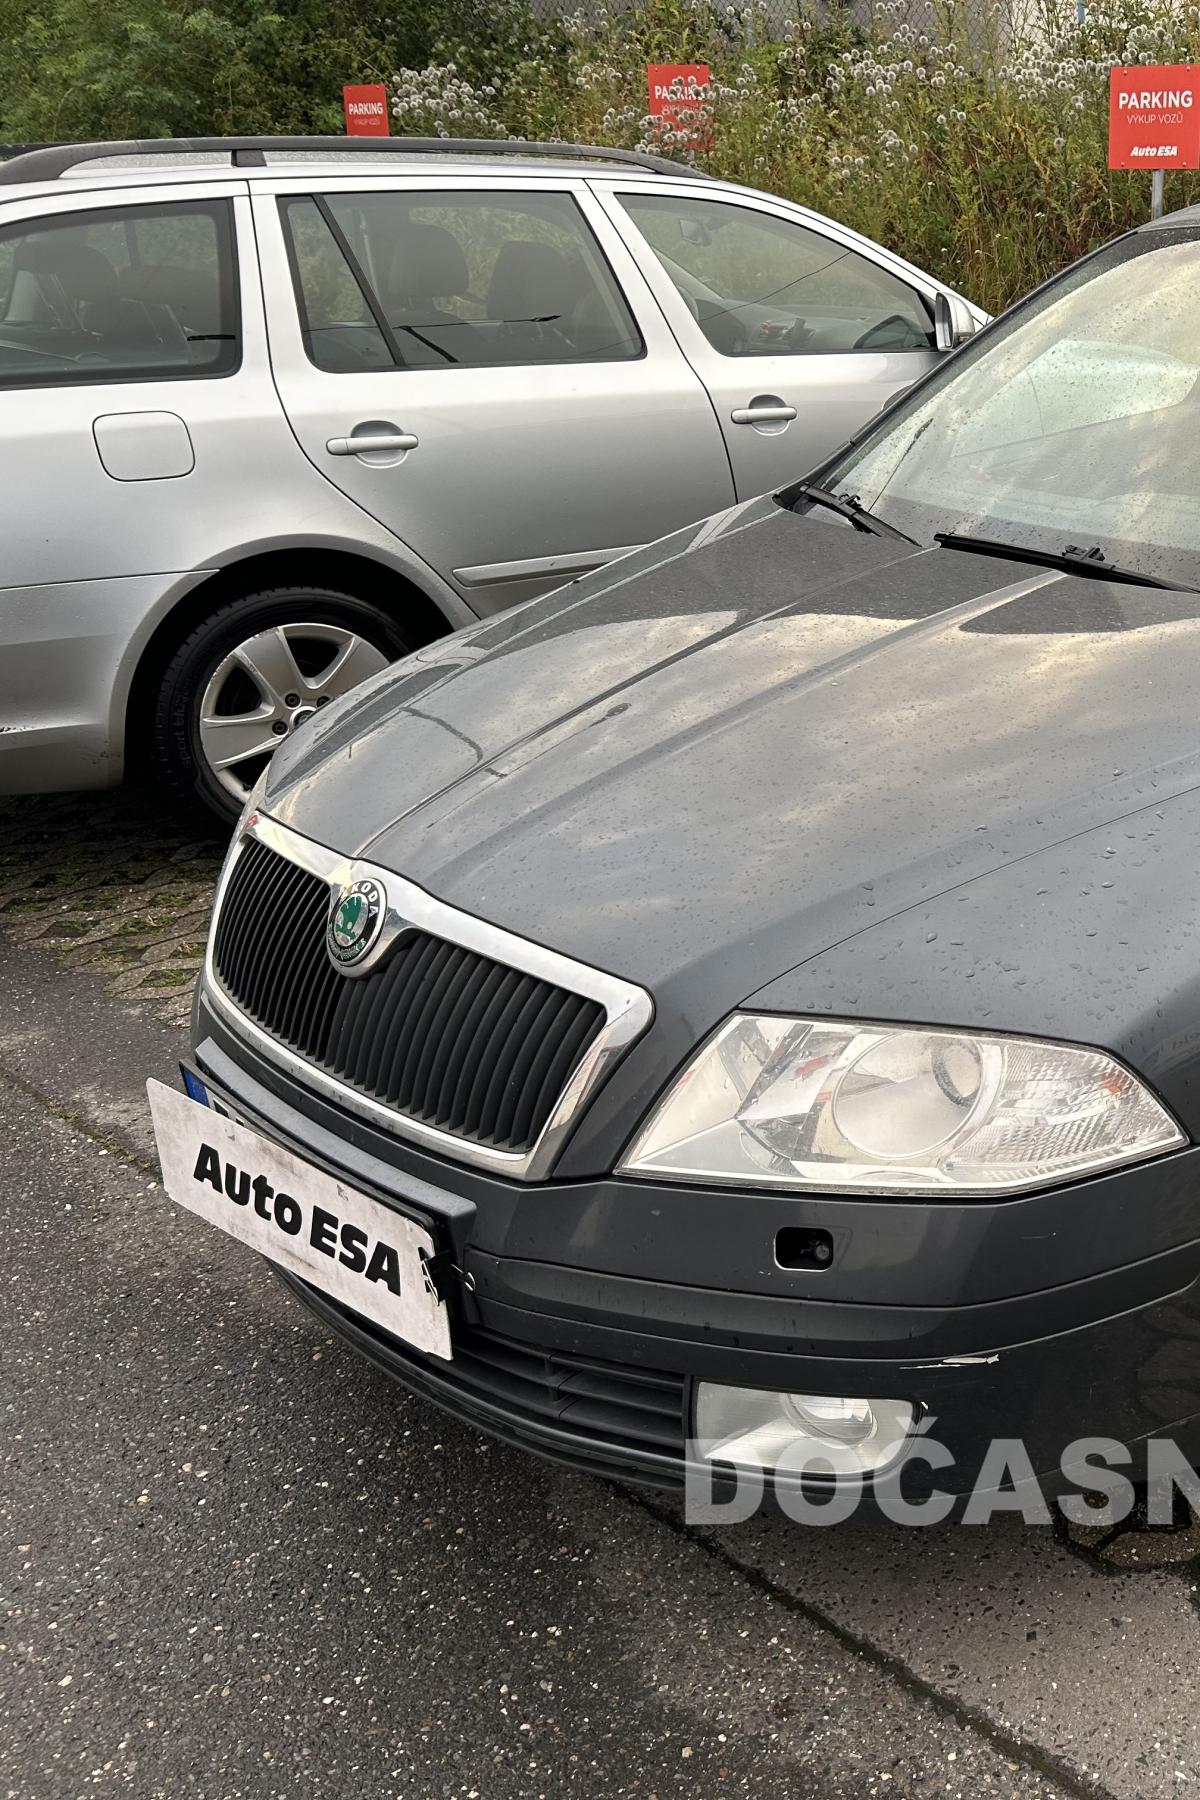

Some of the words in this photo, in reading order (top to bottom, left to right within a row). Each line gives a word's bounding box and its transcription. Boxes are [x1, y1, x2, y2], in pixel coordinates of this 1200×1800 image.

[1118, 90, 1193, 110] PARKING
[348, 102, 384, 116] PARKING
[1126, 112, 1156, 125] VÝKUP
[1158, 111, 1183, 124] VOZŮ
[1130, 145, 1157, 157] Auto
[1157, 145, 1178, 157] ESA
[193, 1142, 302, 1236] Auto
[309, 1204, 402, 1298] ESA
